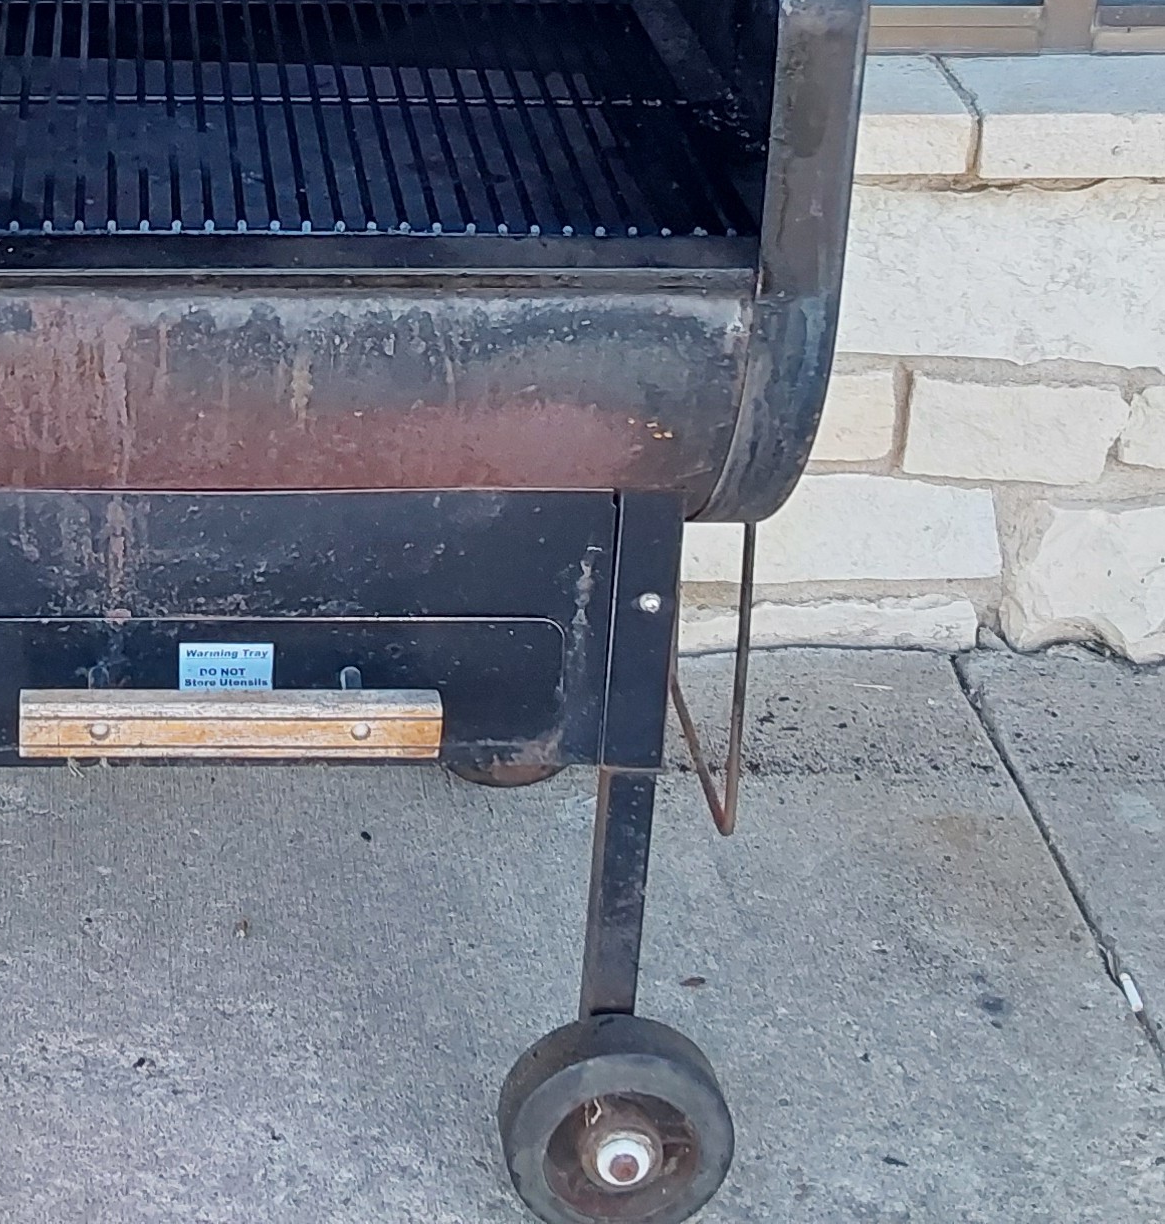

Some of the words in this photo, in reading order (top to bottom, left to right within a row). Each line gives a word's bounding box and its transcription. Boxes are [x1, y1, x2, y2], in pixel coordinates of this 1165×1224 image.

[243, 649, 268, 658] Tray
[199, 668, 217, 676] DO
[221, 668, 246, 676] NOT
[184, 678, 216, 687] Store
[219, 678, 268, 687] Utensils
